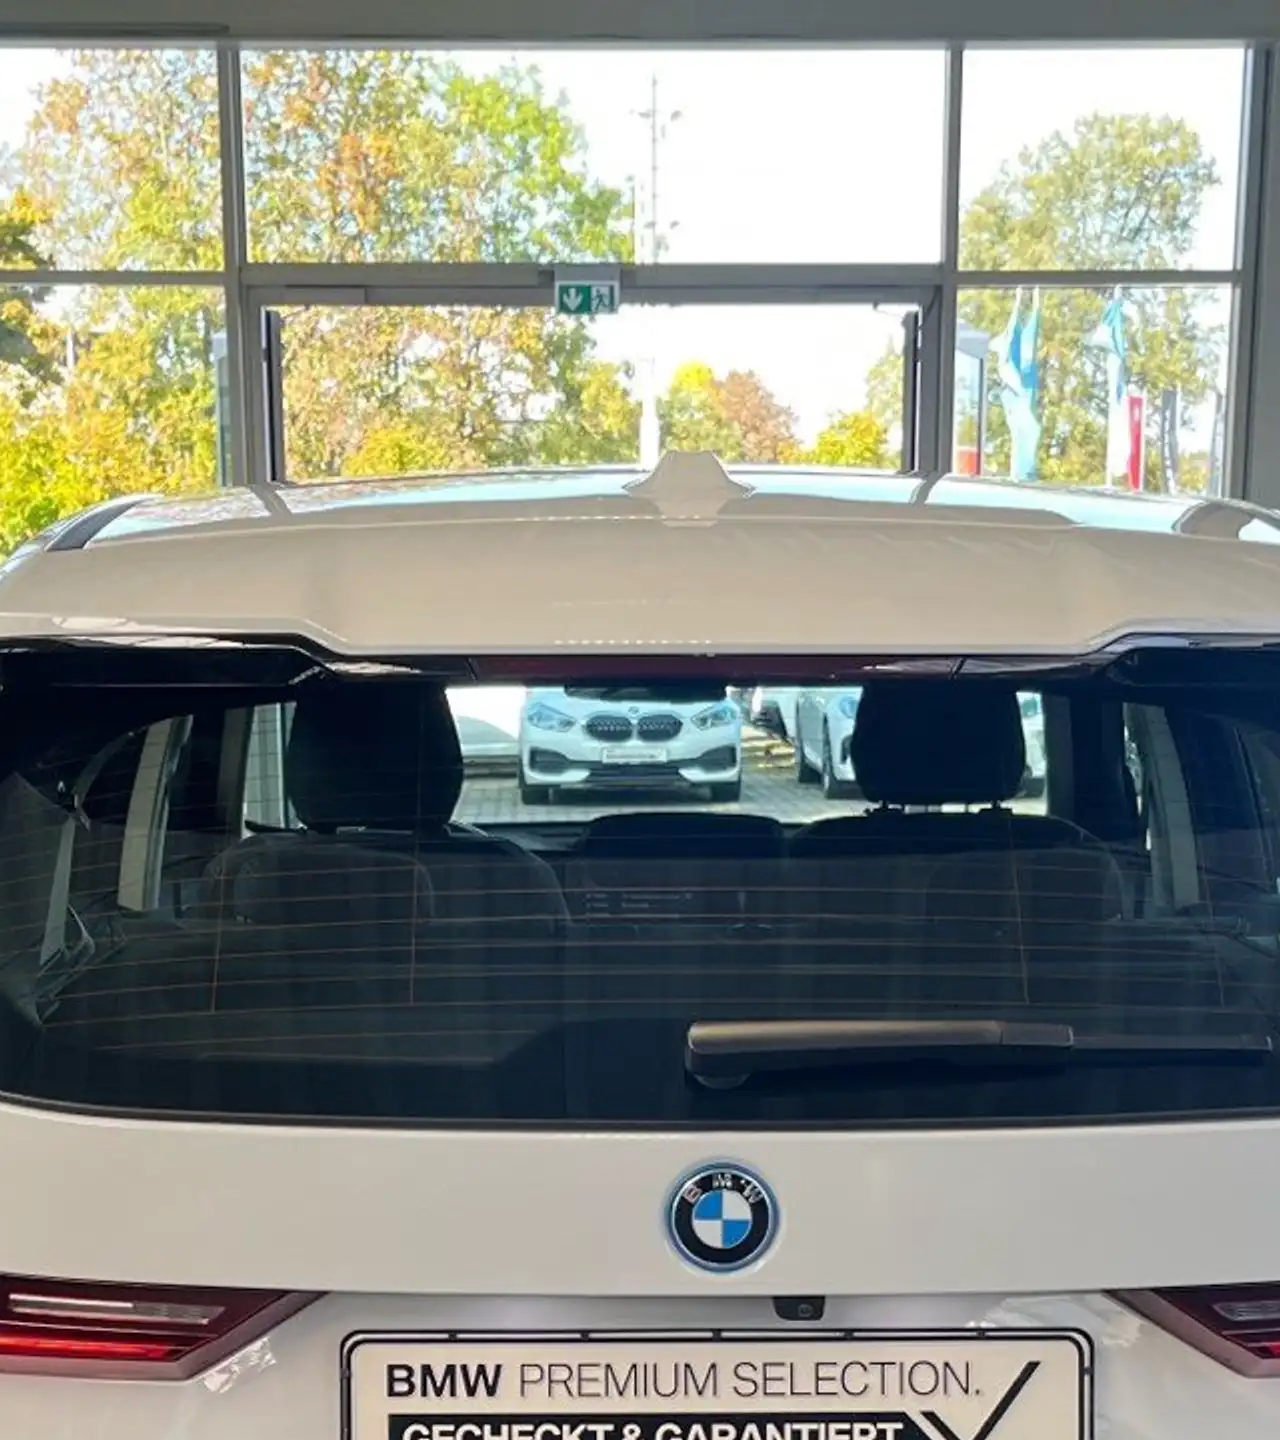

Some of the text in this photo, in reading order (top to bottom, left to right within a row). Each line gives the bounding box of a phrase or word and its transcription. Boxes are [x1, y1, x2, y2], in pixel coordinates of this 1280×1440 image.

[682, 1173, 765, 1204] BMW
[386, 1360, 982, 1398] BMW PREMIUM SELECTION.
